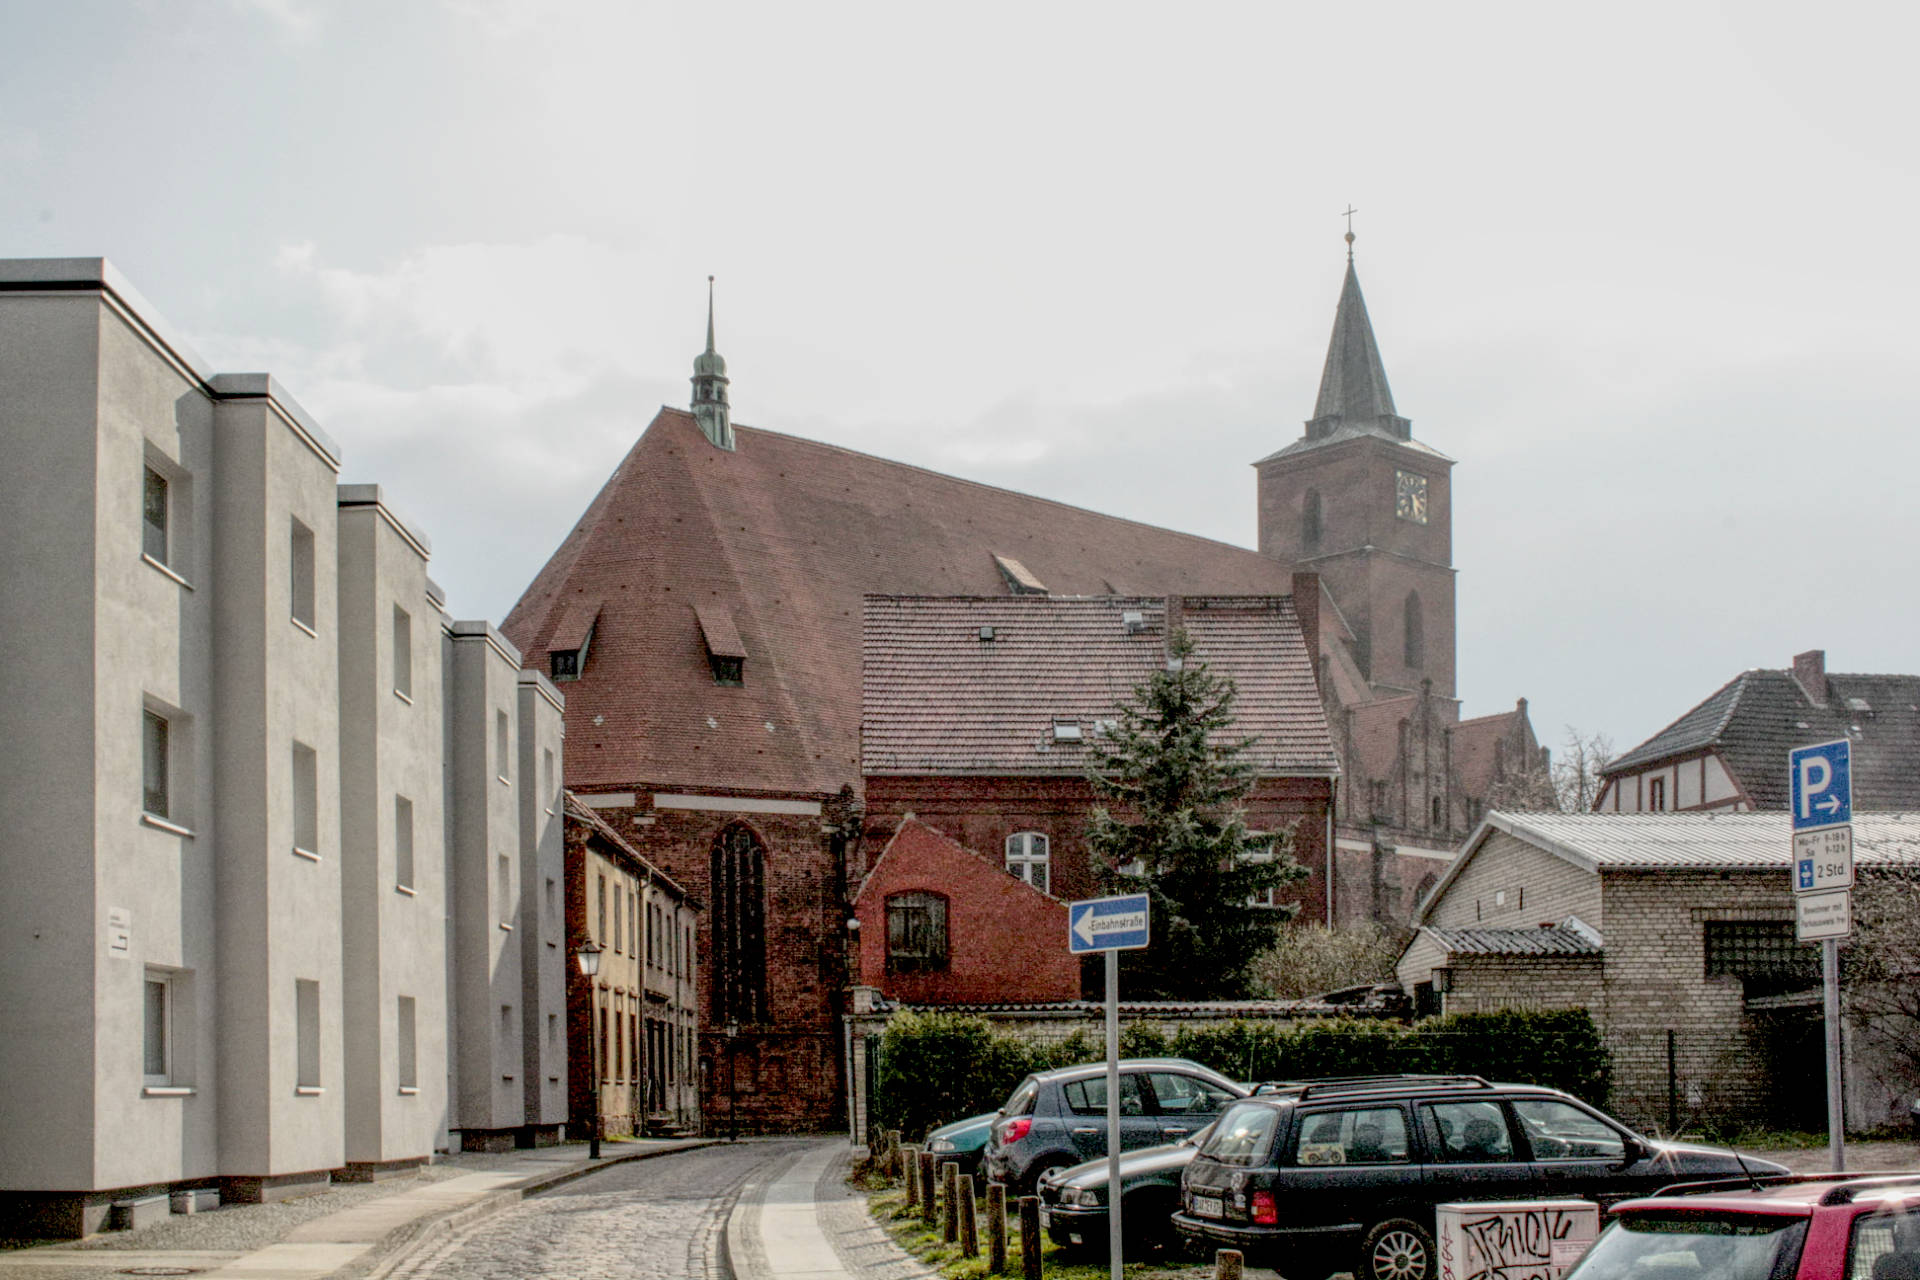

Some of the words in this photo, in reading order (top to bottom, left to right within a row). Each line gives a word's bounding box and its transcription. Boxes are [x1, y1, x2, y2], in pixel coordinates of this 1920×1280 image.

[1801, 756, 1832, 819] P
[1817, 864, 1824, 878] 2
[1826, 862, 1848, 878] Std.
[1091, 915, 1143, 932] Einbahnstraße
